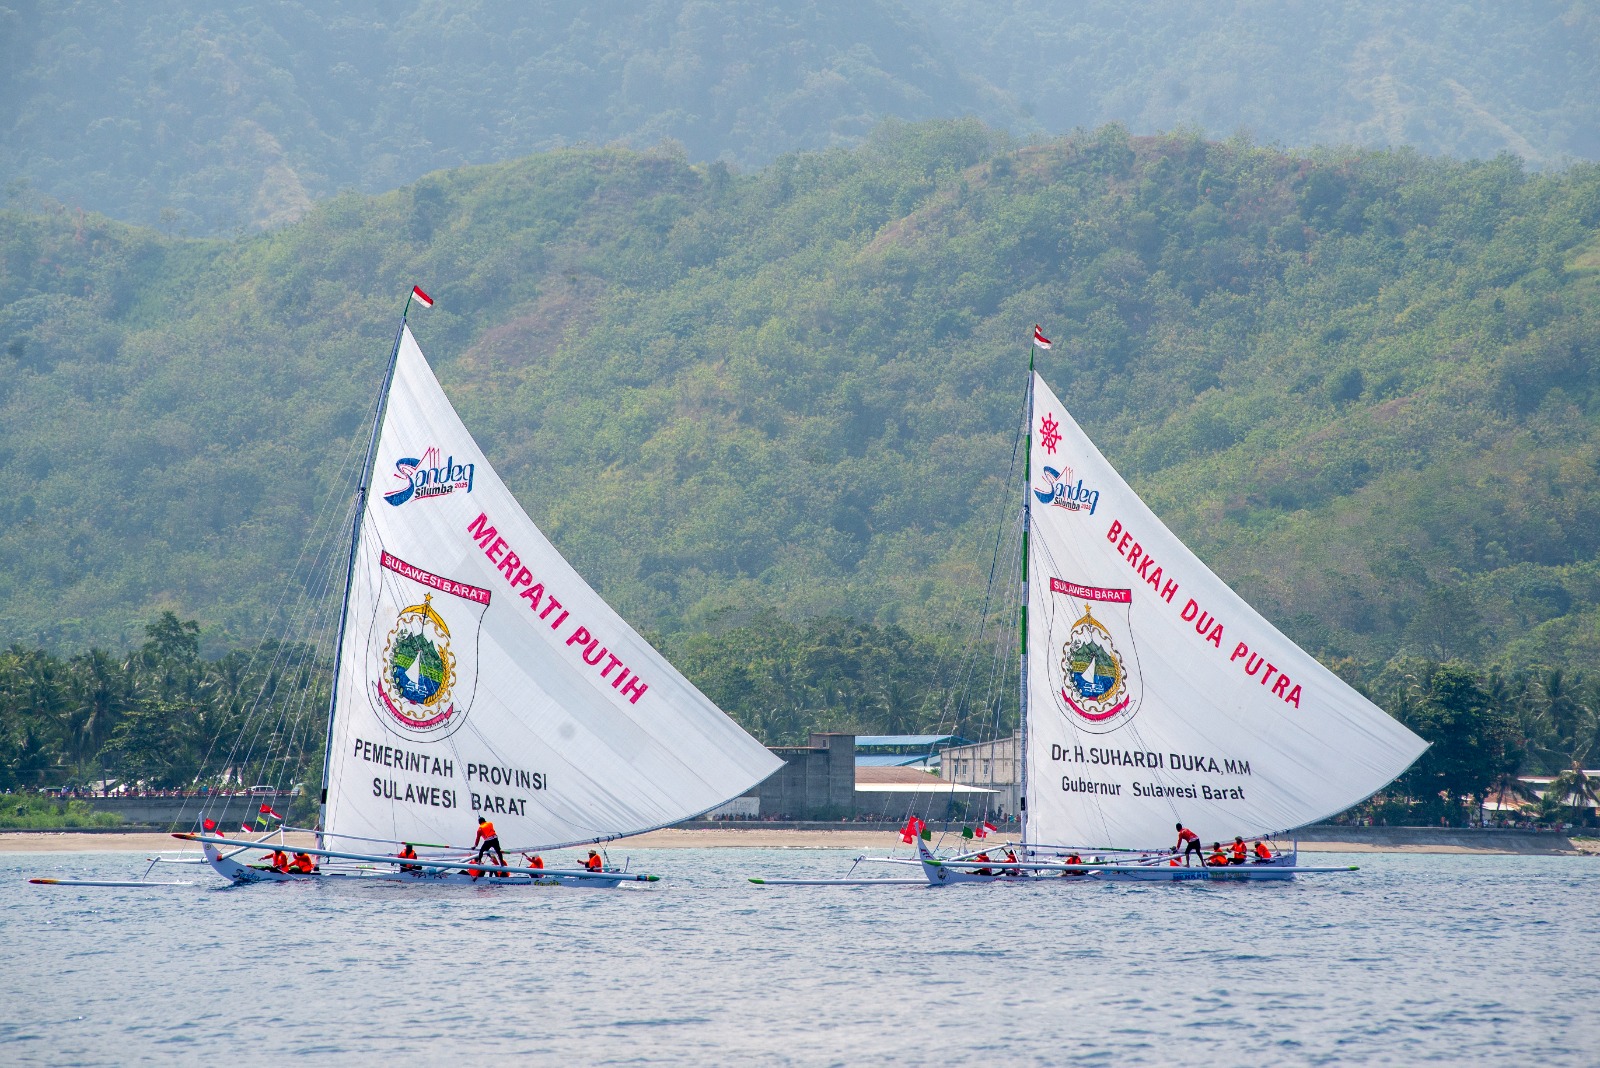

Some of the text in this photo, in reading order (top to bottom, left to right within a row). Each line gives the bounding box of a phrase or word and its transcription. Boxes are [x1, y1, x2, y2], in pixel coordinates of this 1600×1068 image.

[415, 484, 454, 499] Silumba
[1054, 496, 1080, 510] Silumba
[385, 556, 486, 601] SULAWESI BARAT
[1053, 580, 1126, 601] SULAWESI BARAT
[466, 512, 649, 705] MERPATI PUTIH
[1106, 519, 1302, 709] BERKAH DUA PUTRA
[354, 738, 547, 791] PEMERINTAH PROVINSI
[373, 777, 527, 816] SULAWESI BARAT
[1062, 776, 1245, 800] Gubernur Sulawesi Barat
